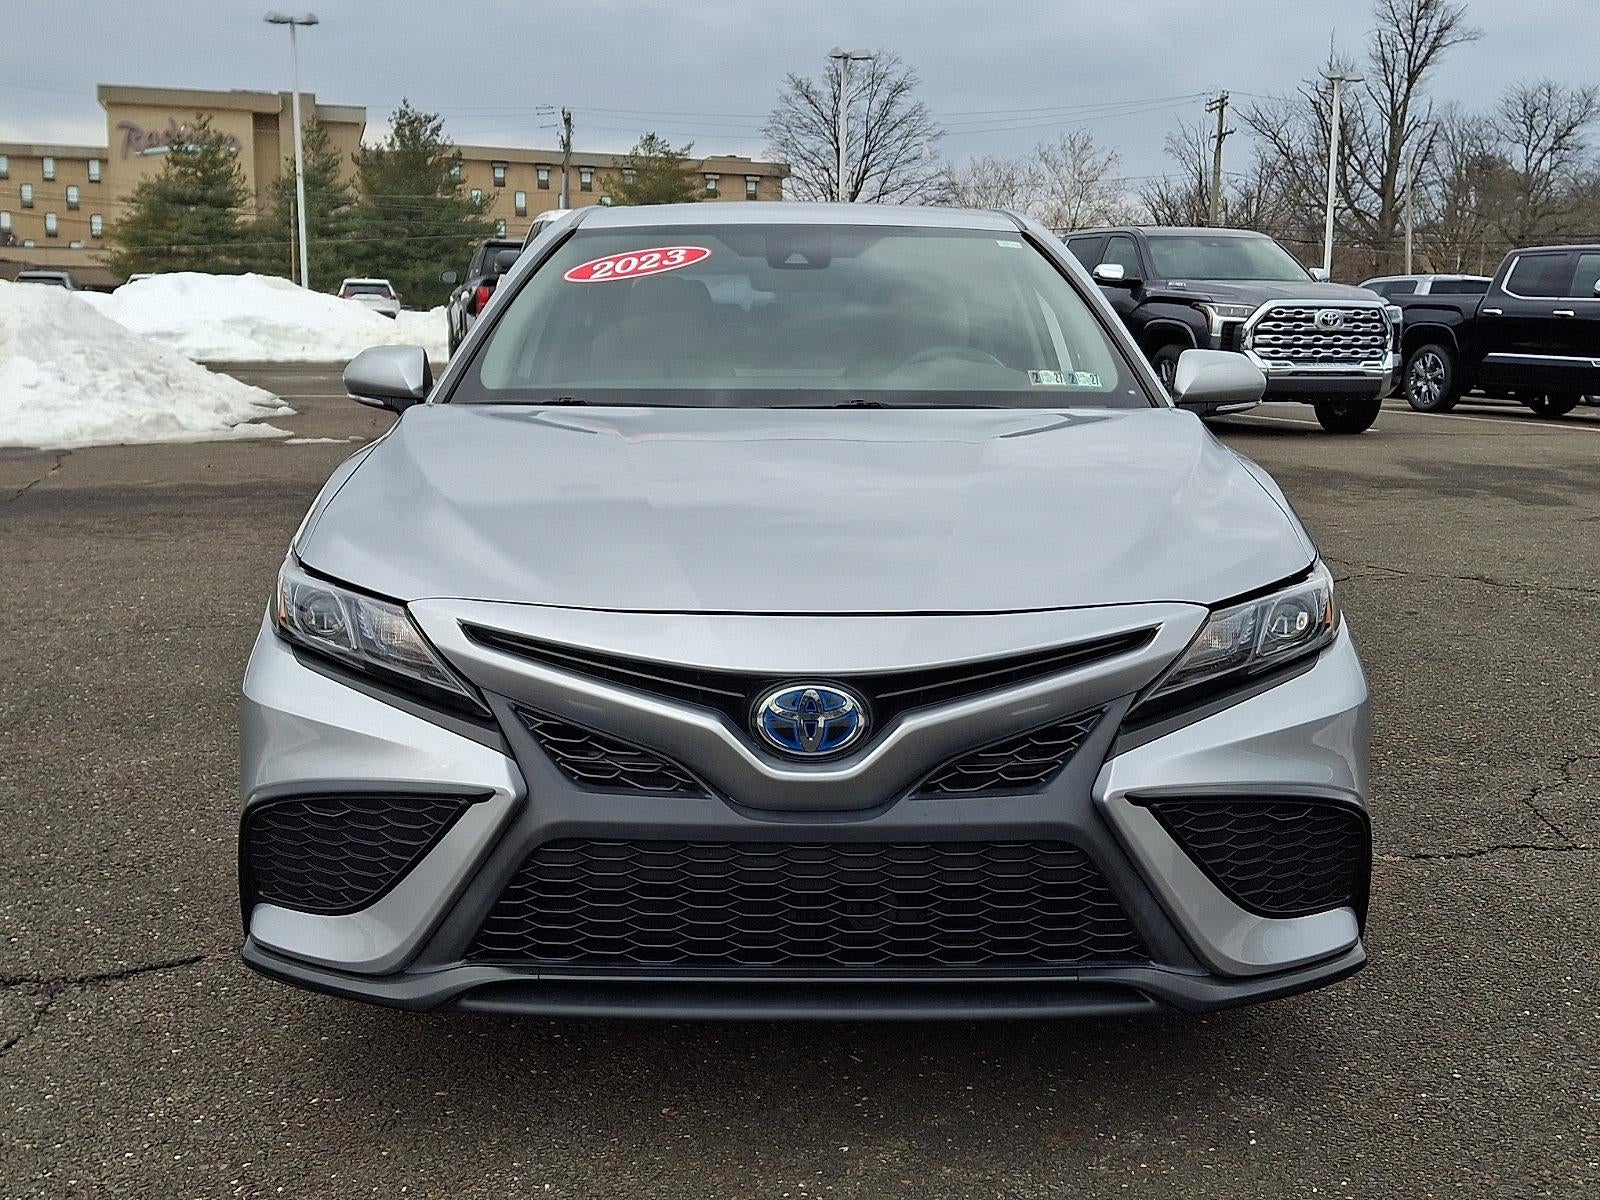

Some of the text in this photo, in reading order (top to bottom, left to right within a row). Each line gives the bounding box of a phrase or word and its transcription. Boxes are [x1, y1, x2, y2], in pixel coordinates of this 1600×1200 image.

[589, 249, 687, 280] 2023
[1053, 372, 1063, 384] 27
[1089, 374, 1099, 385] 27
